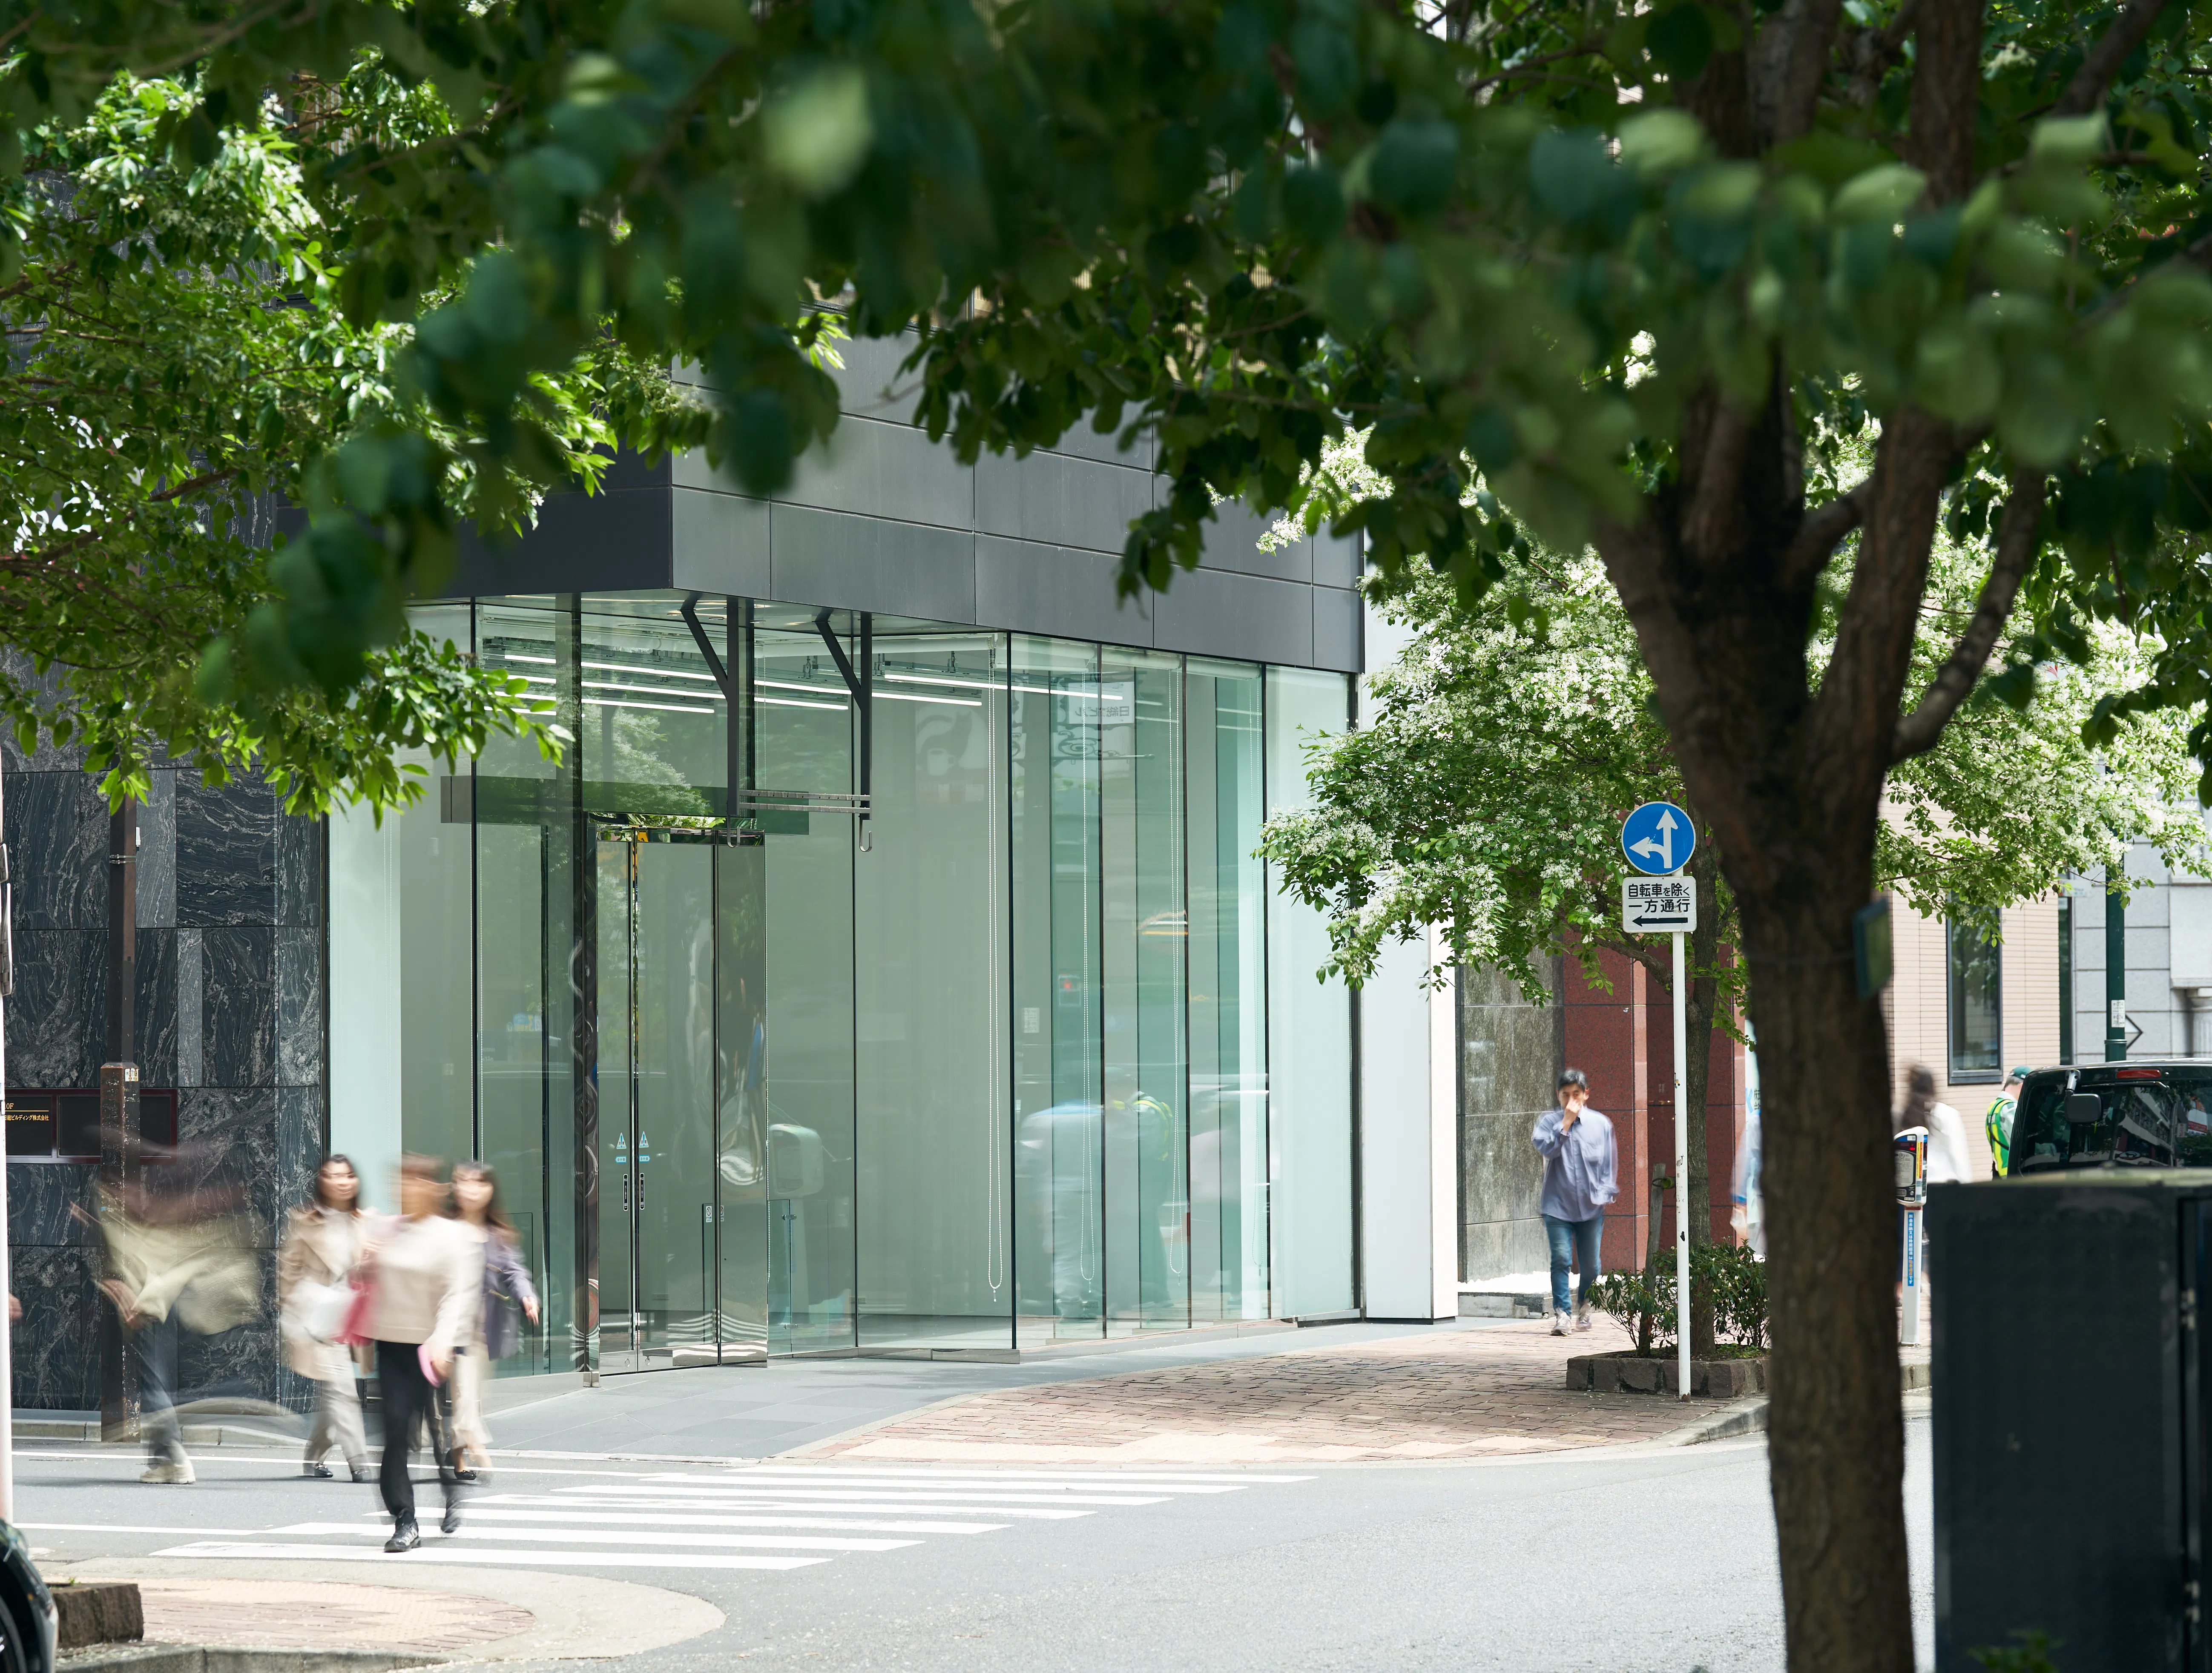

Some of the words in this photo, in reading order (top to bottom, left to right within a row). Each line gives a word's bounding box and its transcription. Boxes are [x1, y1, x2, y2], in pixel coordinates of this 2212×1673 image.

[1628, 883, 1689, 897] 自転車を除く
[1628, 899, 1690, 913] 一方通行
